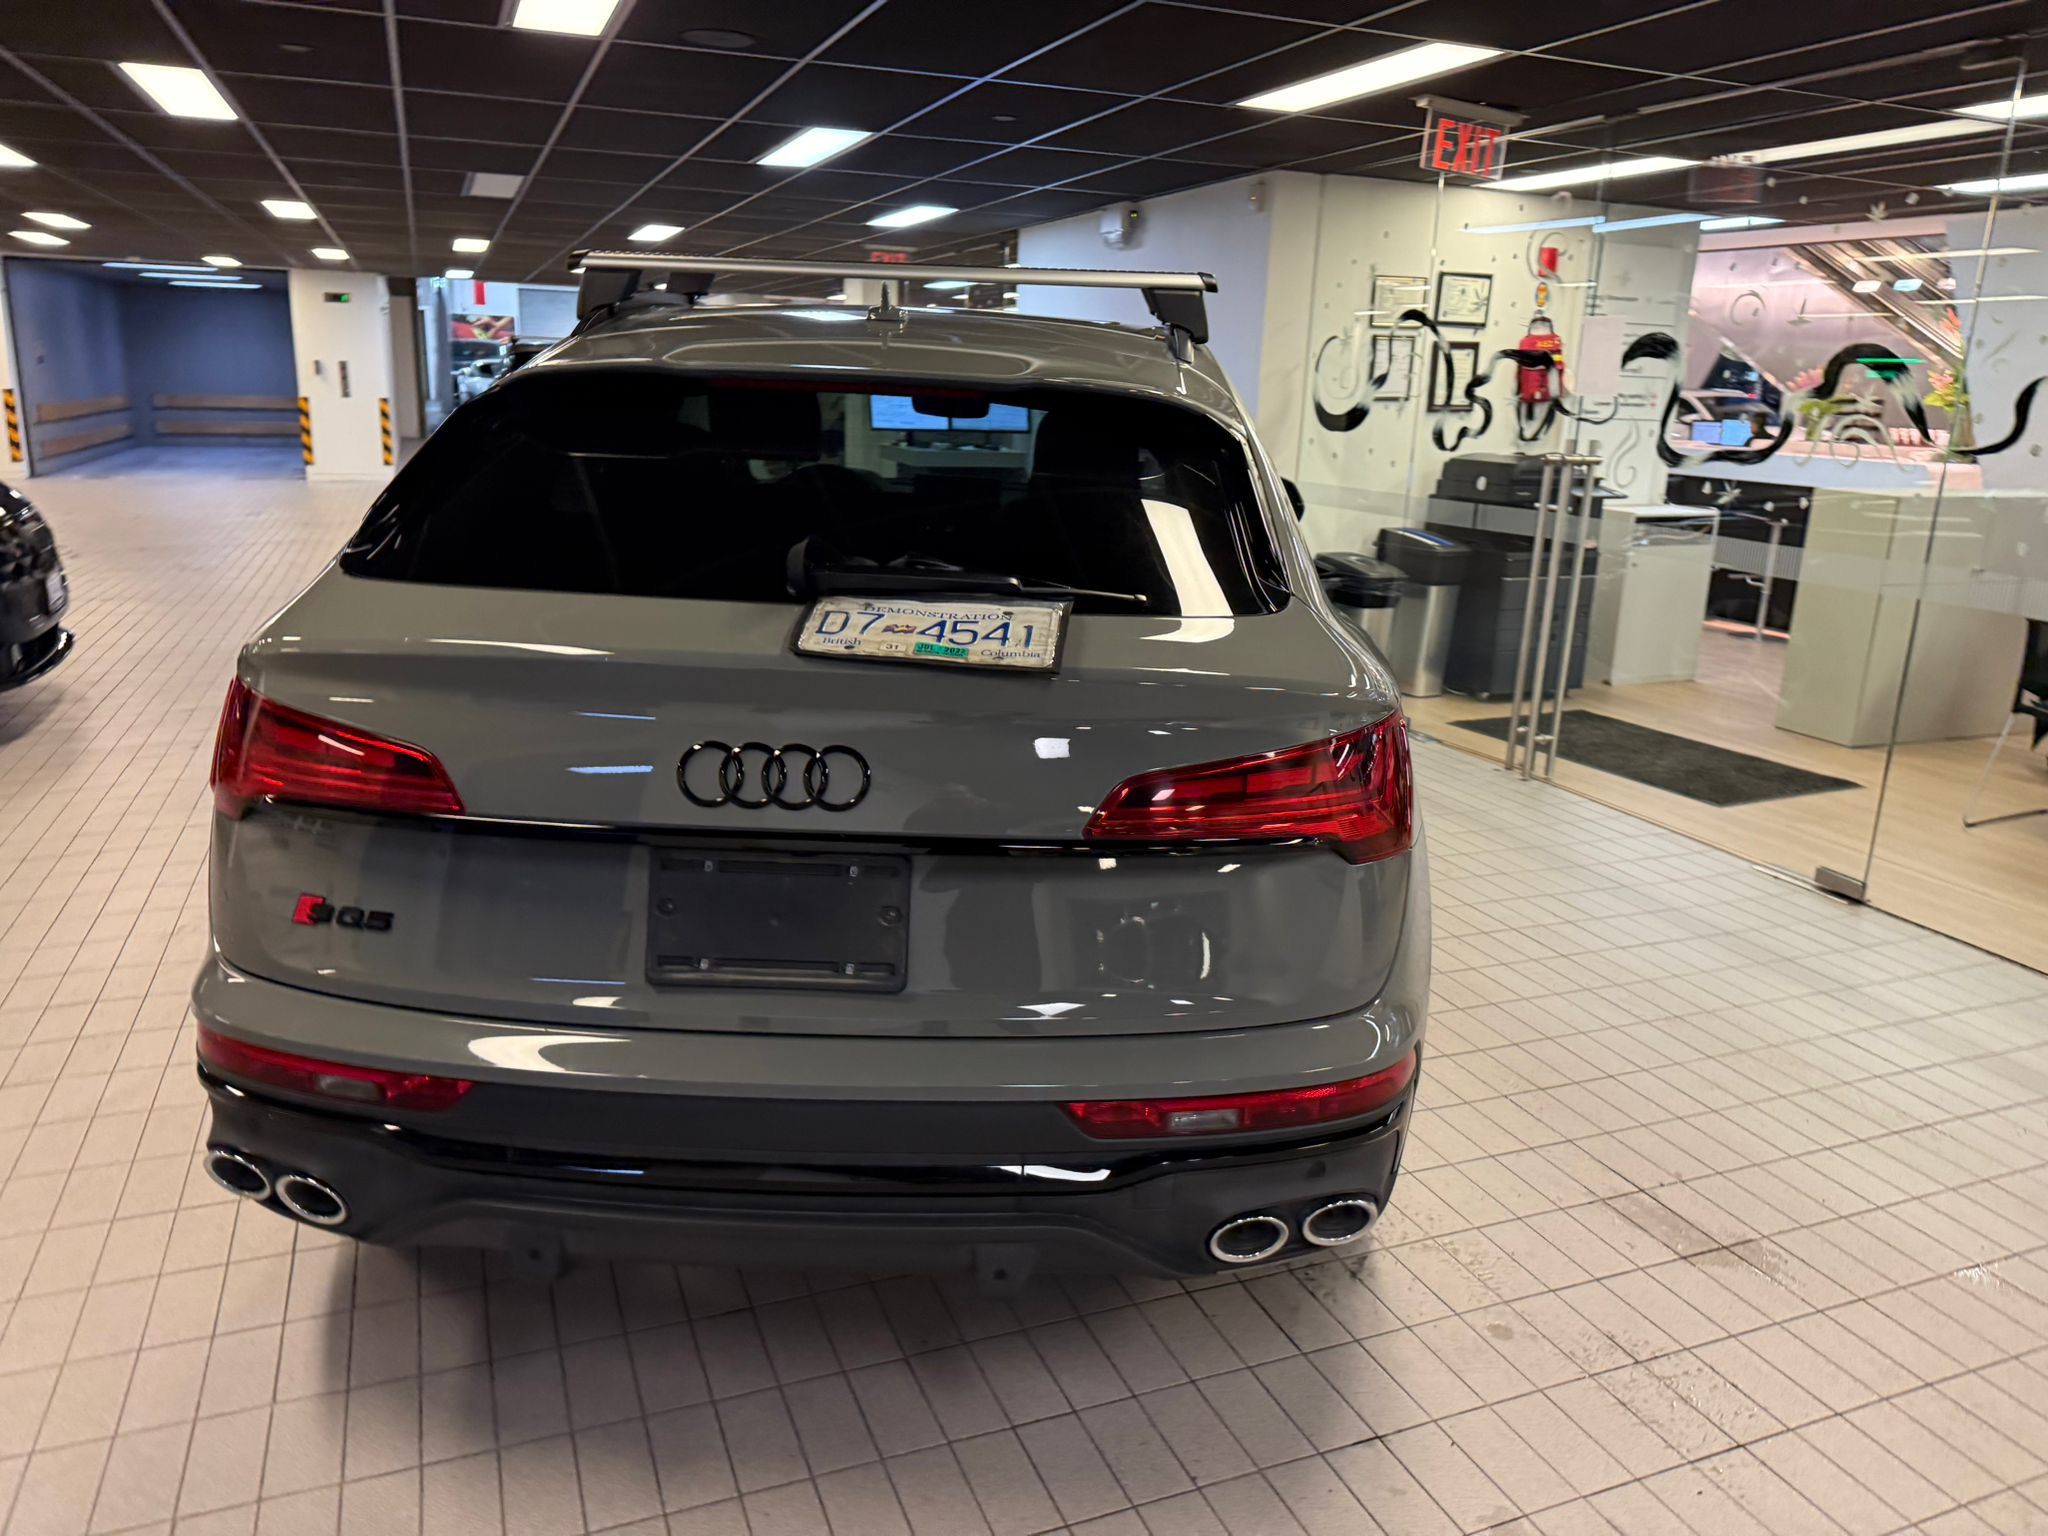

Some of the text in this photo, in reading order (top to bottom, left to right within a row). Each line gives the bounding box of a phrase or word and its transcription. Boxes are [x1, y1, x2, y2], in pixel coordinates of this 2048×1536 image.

[1432, 118, 1502, 179] EXIT
[815, 610, 1034, 649] D7 4541
[863, 605, 1014, 621] DEMONSTRATION
[822, 637, 1041, 659] British Columbia
[304, 898, 395, 931] SQ5
